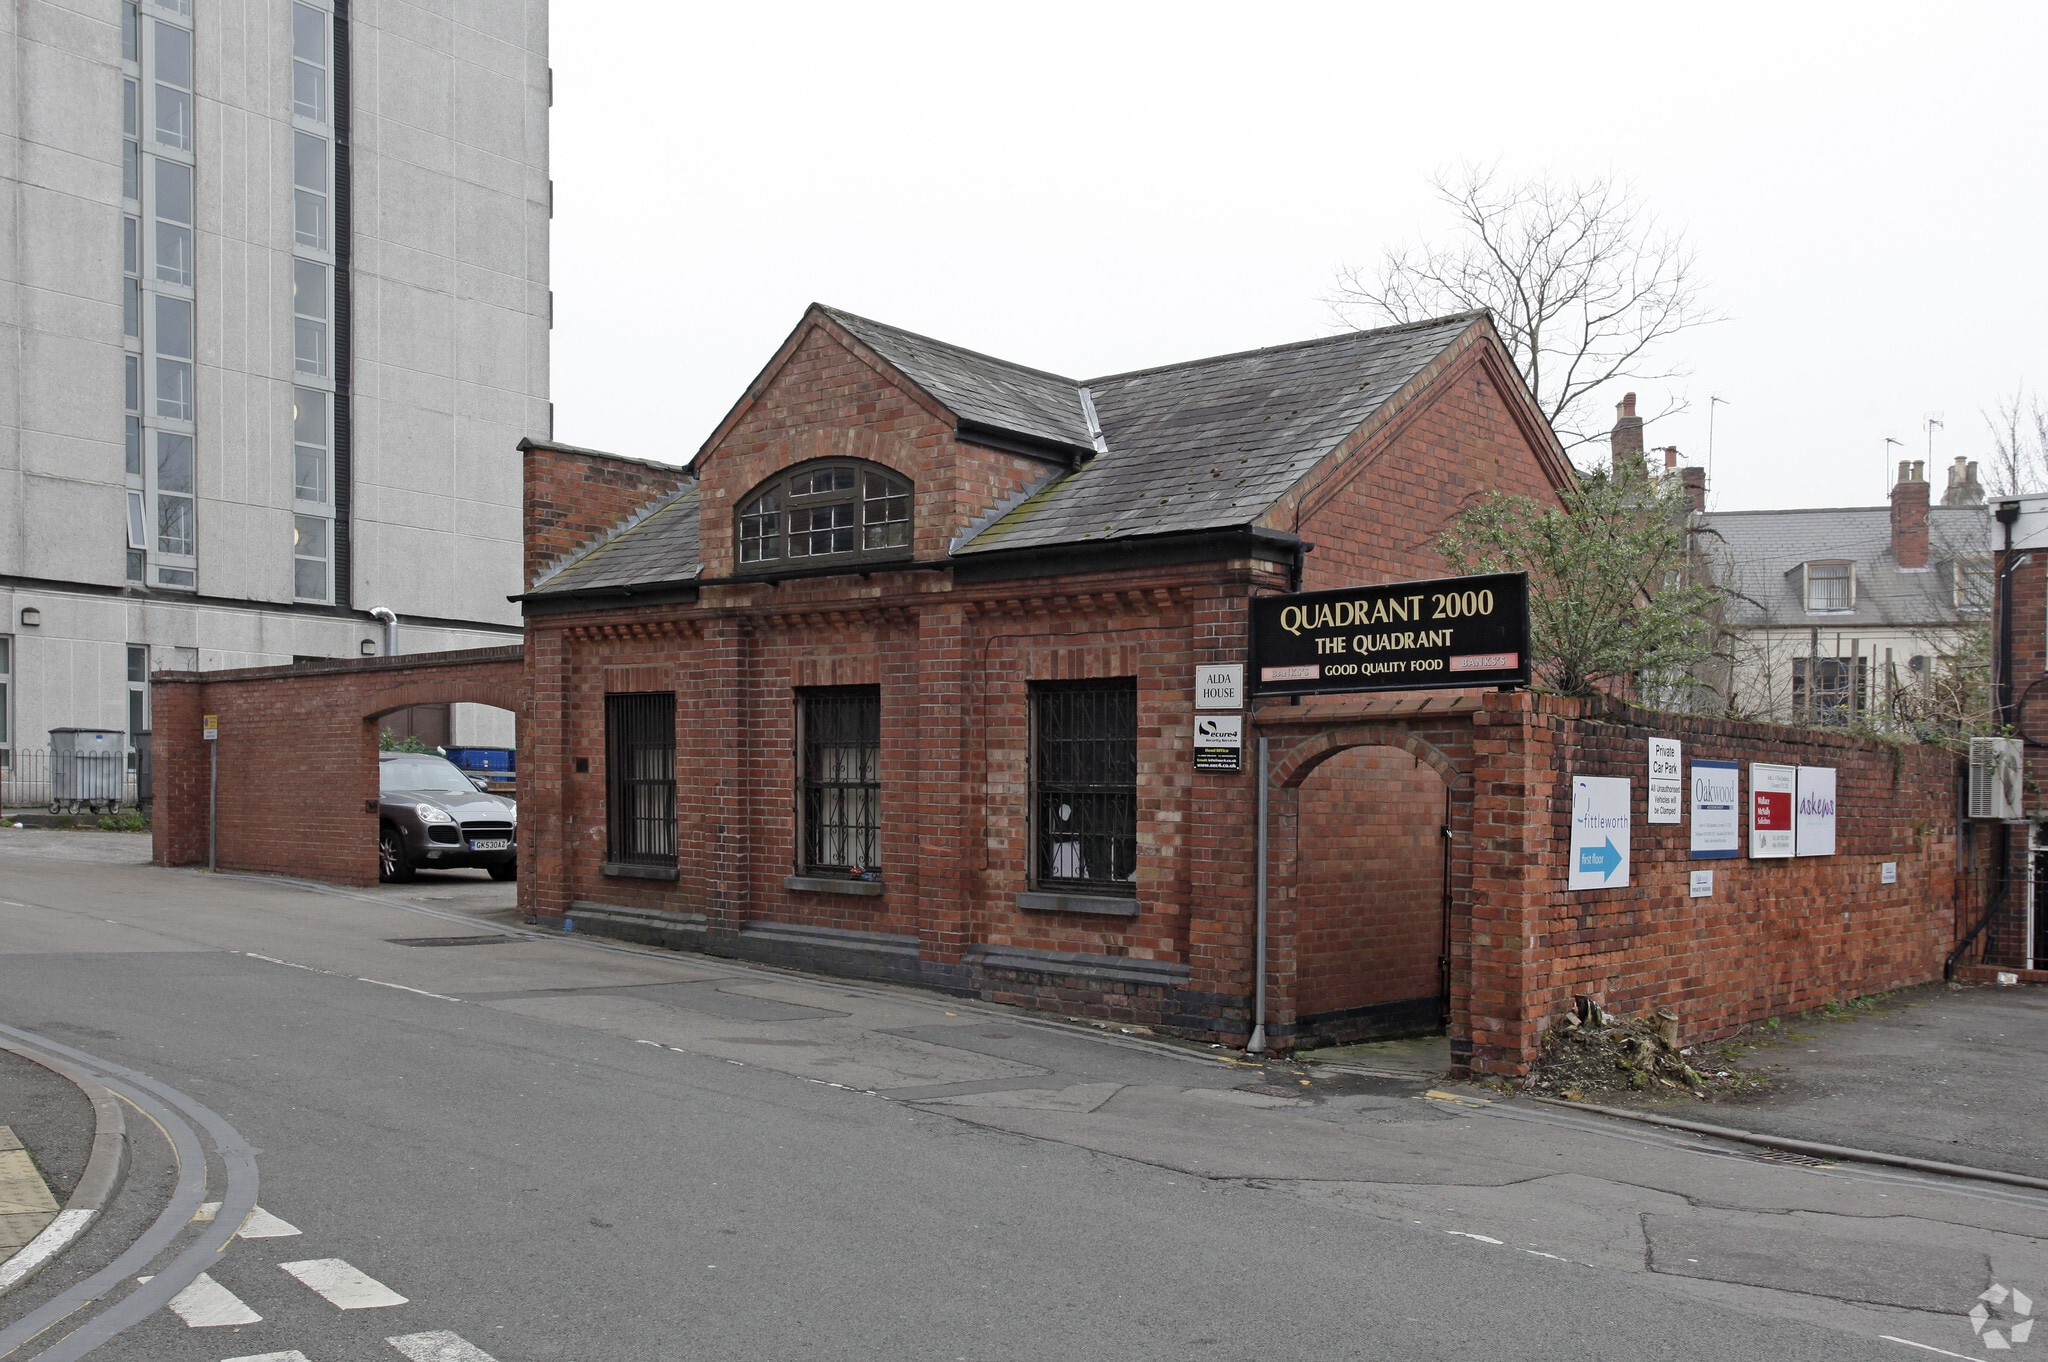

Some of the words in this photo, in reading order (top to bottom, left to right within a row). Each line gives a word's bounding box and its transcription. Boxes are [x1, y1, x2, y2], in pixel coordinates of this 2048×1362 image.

[1280, 594, 1424, 636] QUADRANT
[1431, 589, 1494, 619] 2000
[1315, 636, 1346, 655] THE
[1353, 628, 1454, 656] QUADRANT
[1324, 664, 1358, 676] GOOD
[1361, 660, 1406, 676] QUALITY
[1410, 659, 1443, 672] FOOD
[1461, 656, 1505, 668] BANKS'S
[1206, 674, 1231, 684] ALDA
[1272, 667, 1309, 678] BANKS'S
[1203, 688, 1235, 698] HOUSE
[1655, 744, 1675, 758] Private
[1653, 761, 1664, 773] Car
[1665, 762, 1677, 774] Park
[1656, 784, 1681, 793] Unauthorised
[1695, 778, 1735, 803] Oakwood
[1655, 796, 1670, 804] Vehicles
[1654, 806, 1659, 814] be
[1660, 806, 1676, 816] Clamped
[1584, 813, 1629, 829] fittleworth
[1581, 853, 1592, 865] first
[1592, 852, 1605, 865] floor
